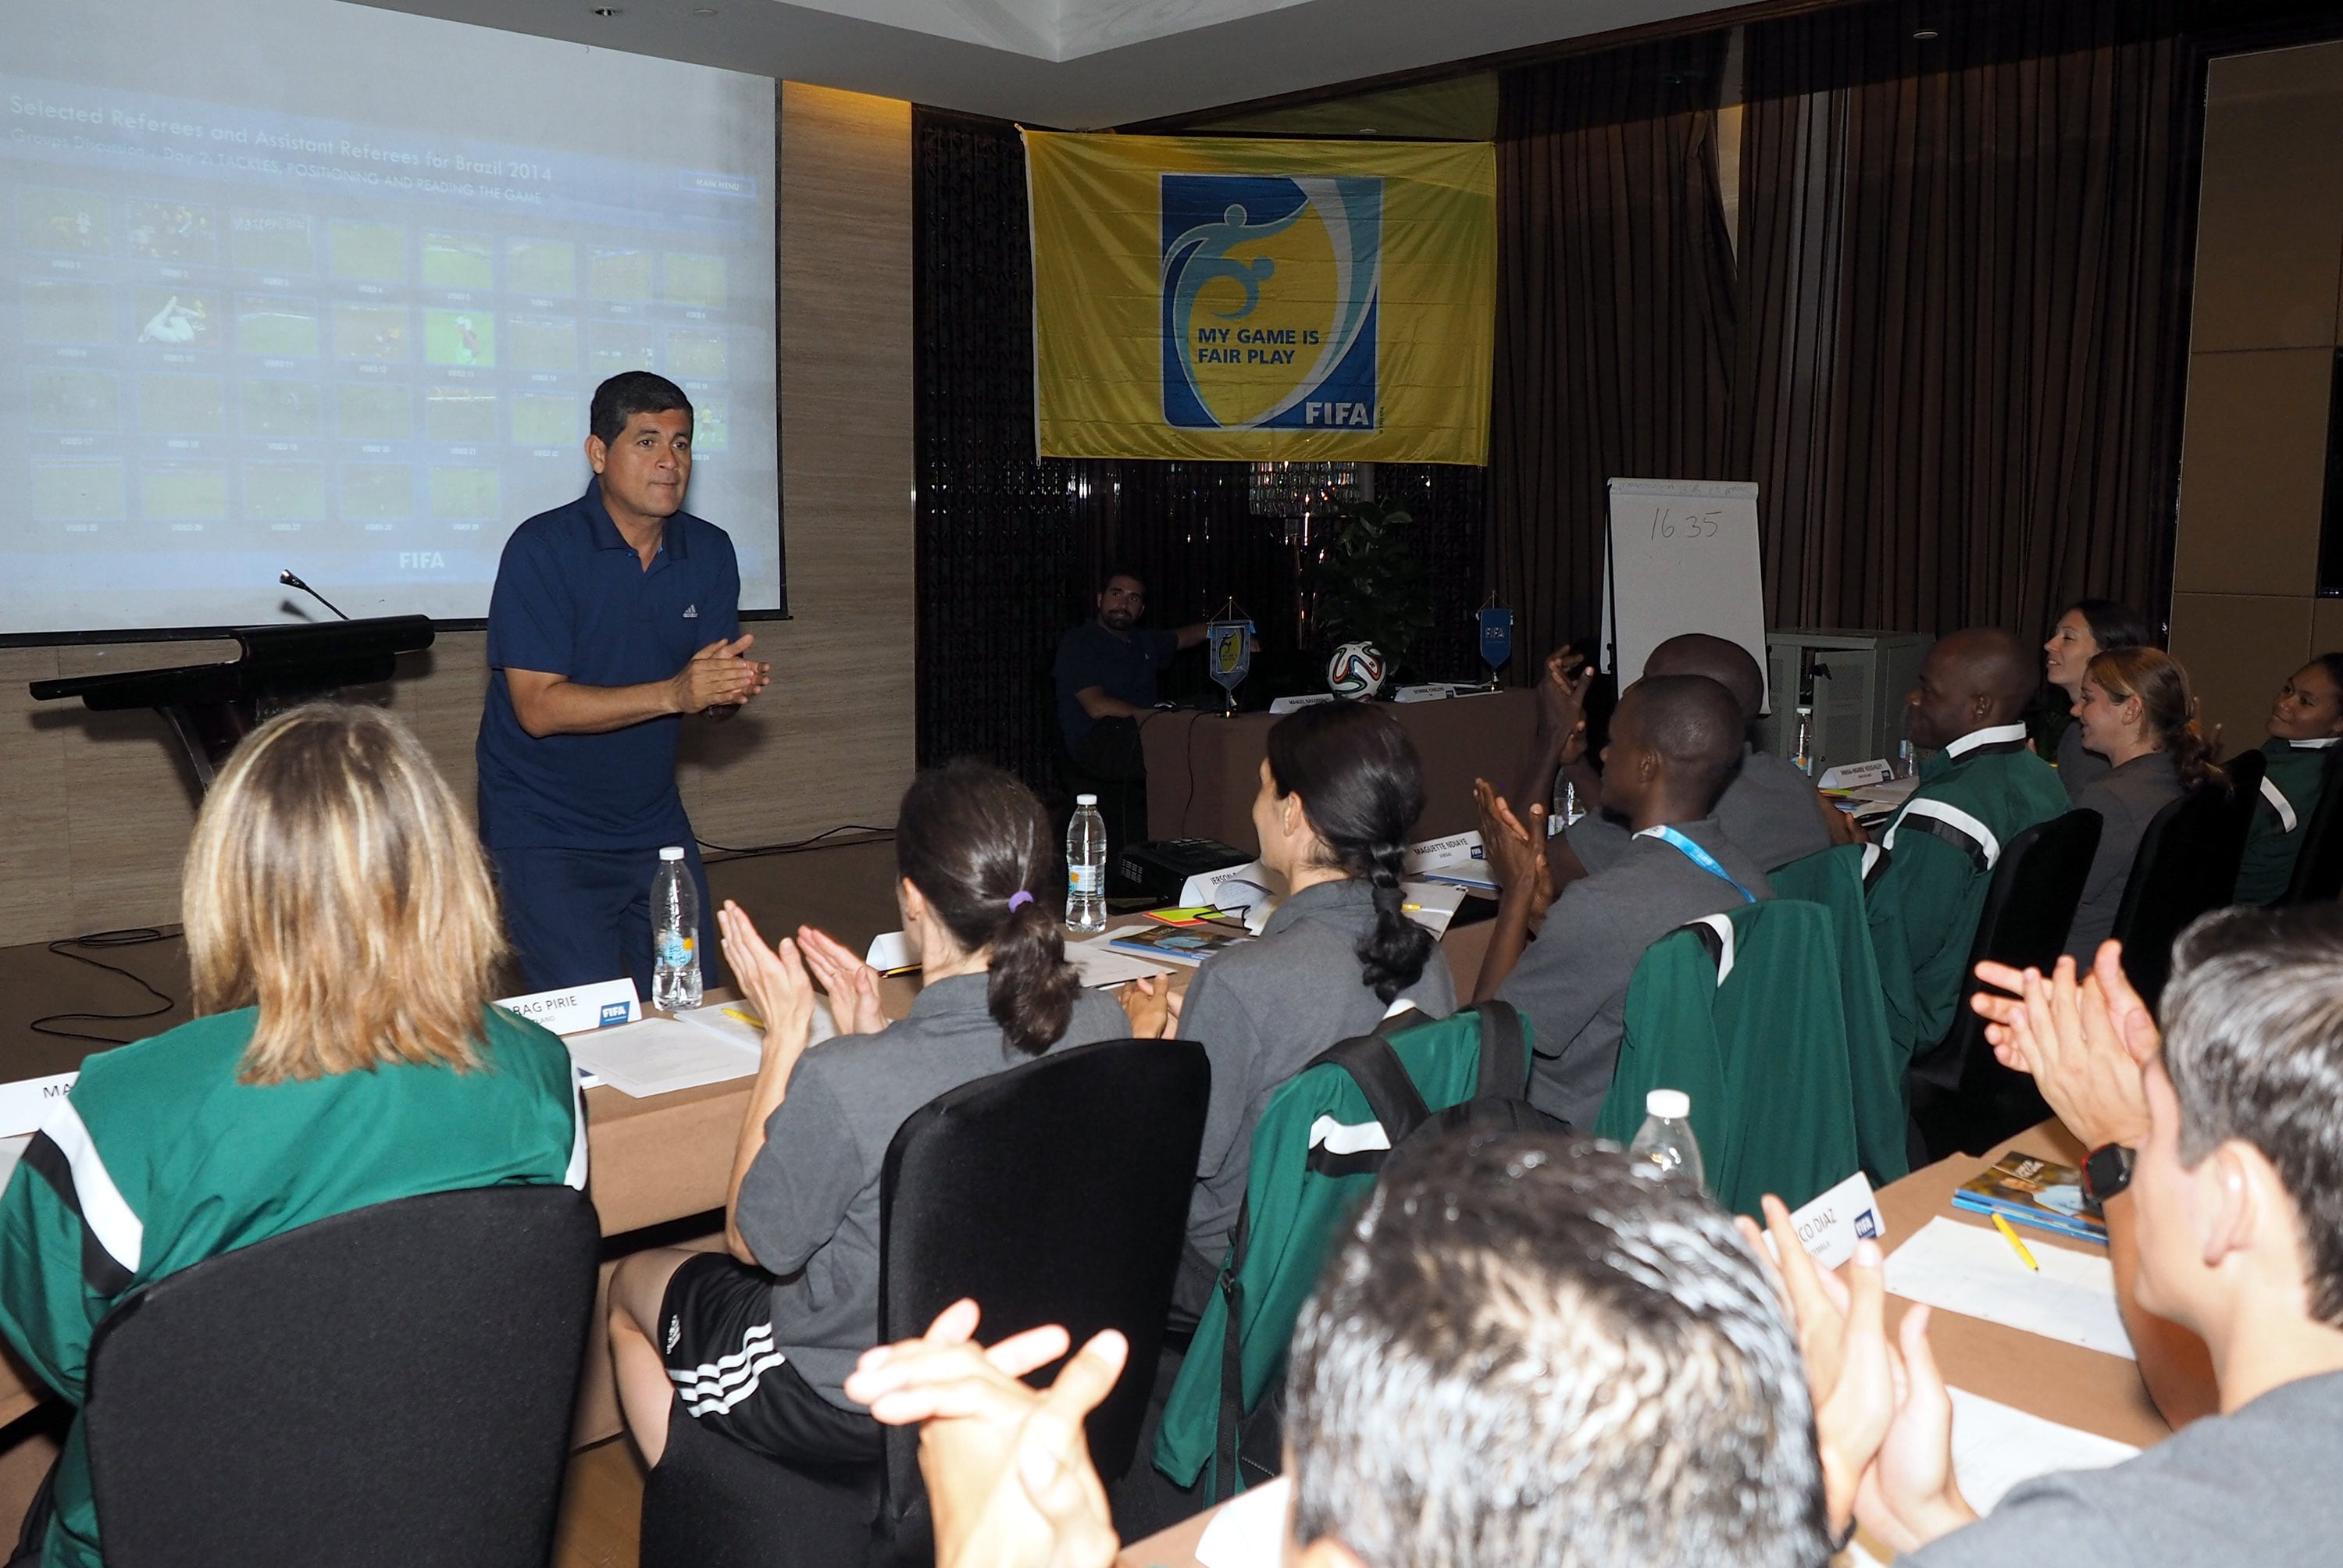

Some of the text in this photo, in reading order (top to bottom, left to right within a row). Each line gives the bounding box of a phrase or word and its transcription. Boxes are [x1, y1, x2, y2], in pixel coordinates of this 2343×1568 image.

[11, 95, 551, 181] Selected Referees and Assistant Referees for Brazil 2014
[75, 136, 145, 156] Discussion
[162, 147, 192, 165] Day
[287, 162, 379, 185] POSITIONING
[383, 175, 413, 189] AND
[416, 179, 474, 196] READING
[479, 185, 501, 200] THE
[505, 188, 543, 204] GAME
[1198, 328, 1320, 345] MY GAME IS
[1198, 348, 1296, 365] FAIR PLAY
[1305, 401, 1369, 426] FIFA
[399, 551, 445, 568] FIFA
[1485, 626, 1505, 638] FIFA
[1414, 838, 1468, 855] MAGUETTE NDIAYE
[545, 996, 578, 1010] PIRIE
[602, 1006, 626, 1018] FIFA
[1813, 1208, 1837, 1233] DIAZ
[1855, 1216, 1874, 1237] FIFA
